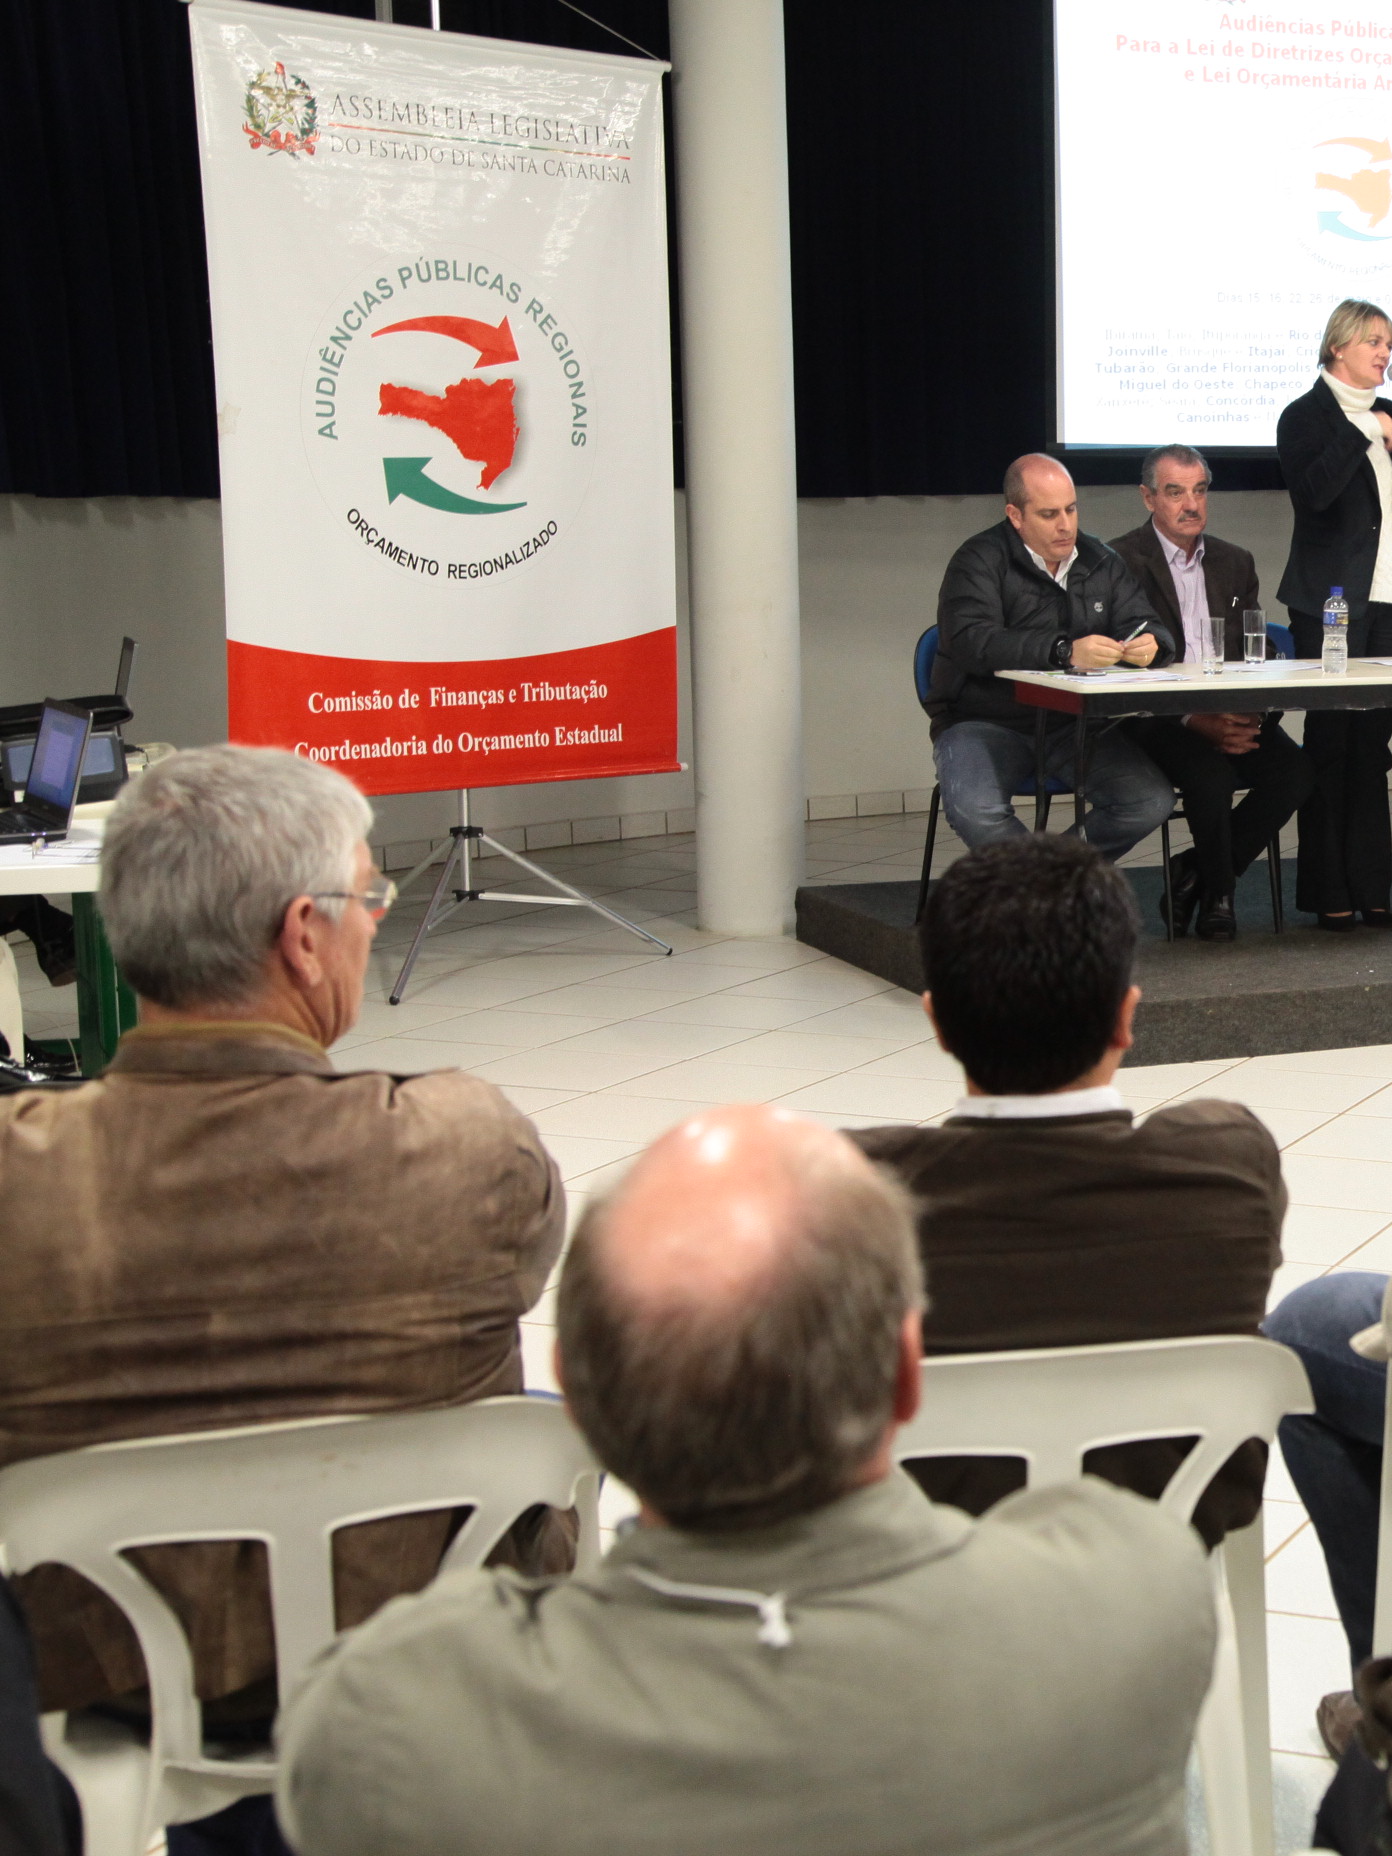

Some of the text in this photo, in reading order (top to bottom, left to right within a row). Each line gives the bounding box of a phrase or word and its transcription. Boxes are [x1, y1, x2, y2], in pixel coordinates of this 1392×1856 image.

[1219, 13, 1326, 35] Audiências
[1116, 34, 1161, 53] Para
[1168, 41, 1179, 54] a
[1187, 38, 1215, 57] Lei
[1222, 40, 1245, 57] de
[1251, 41, 1345, 63] Diretrizes
[1184, 69, 1195, 82] e
[1202, 65, 1231, 84] Lei
[1237, 67, 1367, 90] Orçamentária
[331, 93, 631, 150] ASSEMBLEIA LEGISLATIVA
[331, 134, 360, 155] DO
[369, 139, 444, 164] ESTADO
[452, 149, 475, 167] DE
[482, 153, 537, 175] SANTA
[544, 160, 631, 184] CATARINA
[316, 256, 588, 448] AUDIÊNCIAS PÚBLICAS REGIONAIS
[1166, 363, 1217, 374] Grande
[1119, 379, 1167, 392] Miguel
[346, 508, 558, 580] ORÇAMENTO REGIONALIZADO
[308, 679, 608, 714] Comissão de Finanças e Tributação
[294, 723, 624, 762] Coordenadoria do Orçamento Estadual
